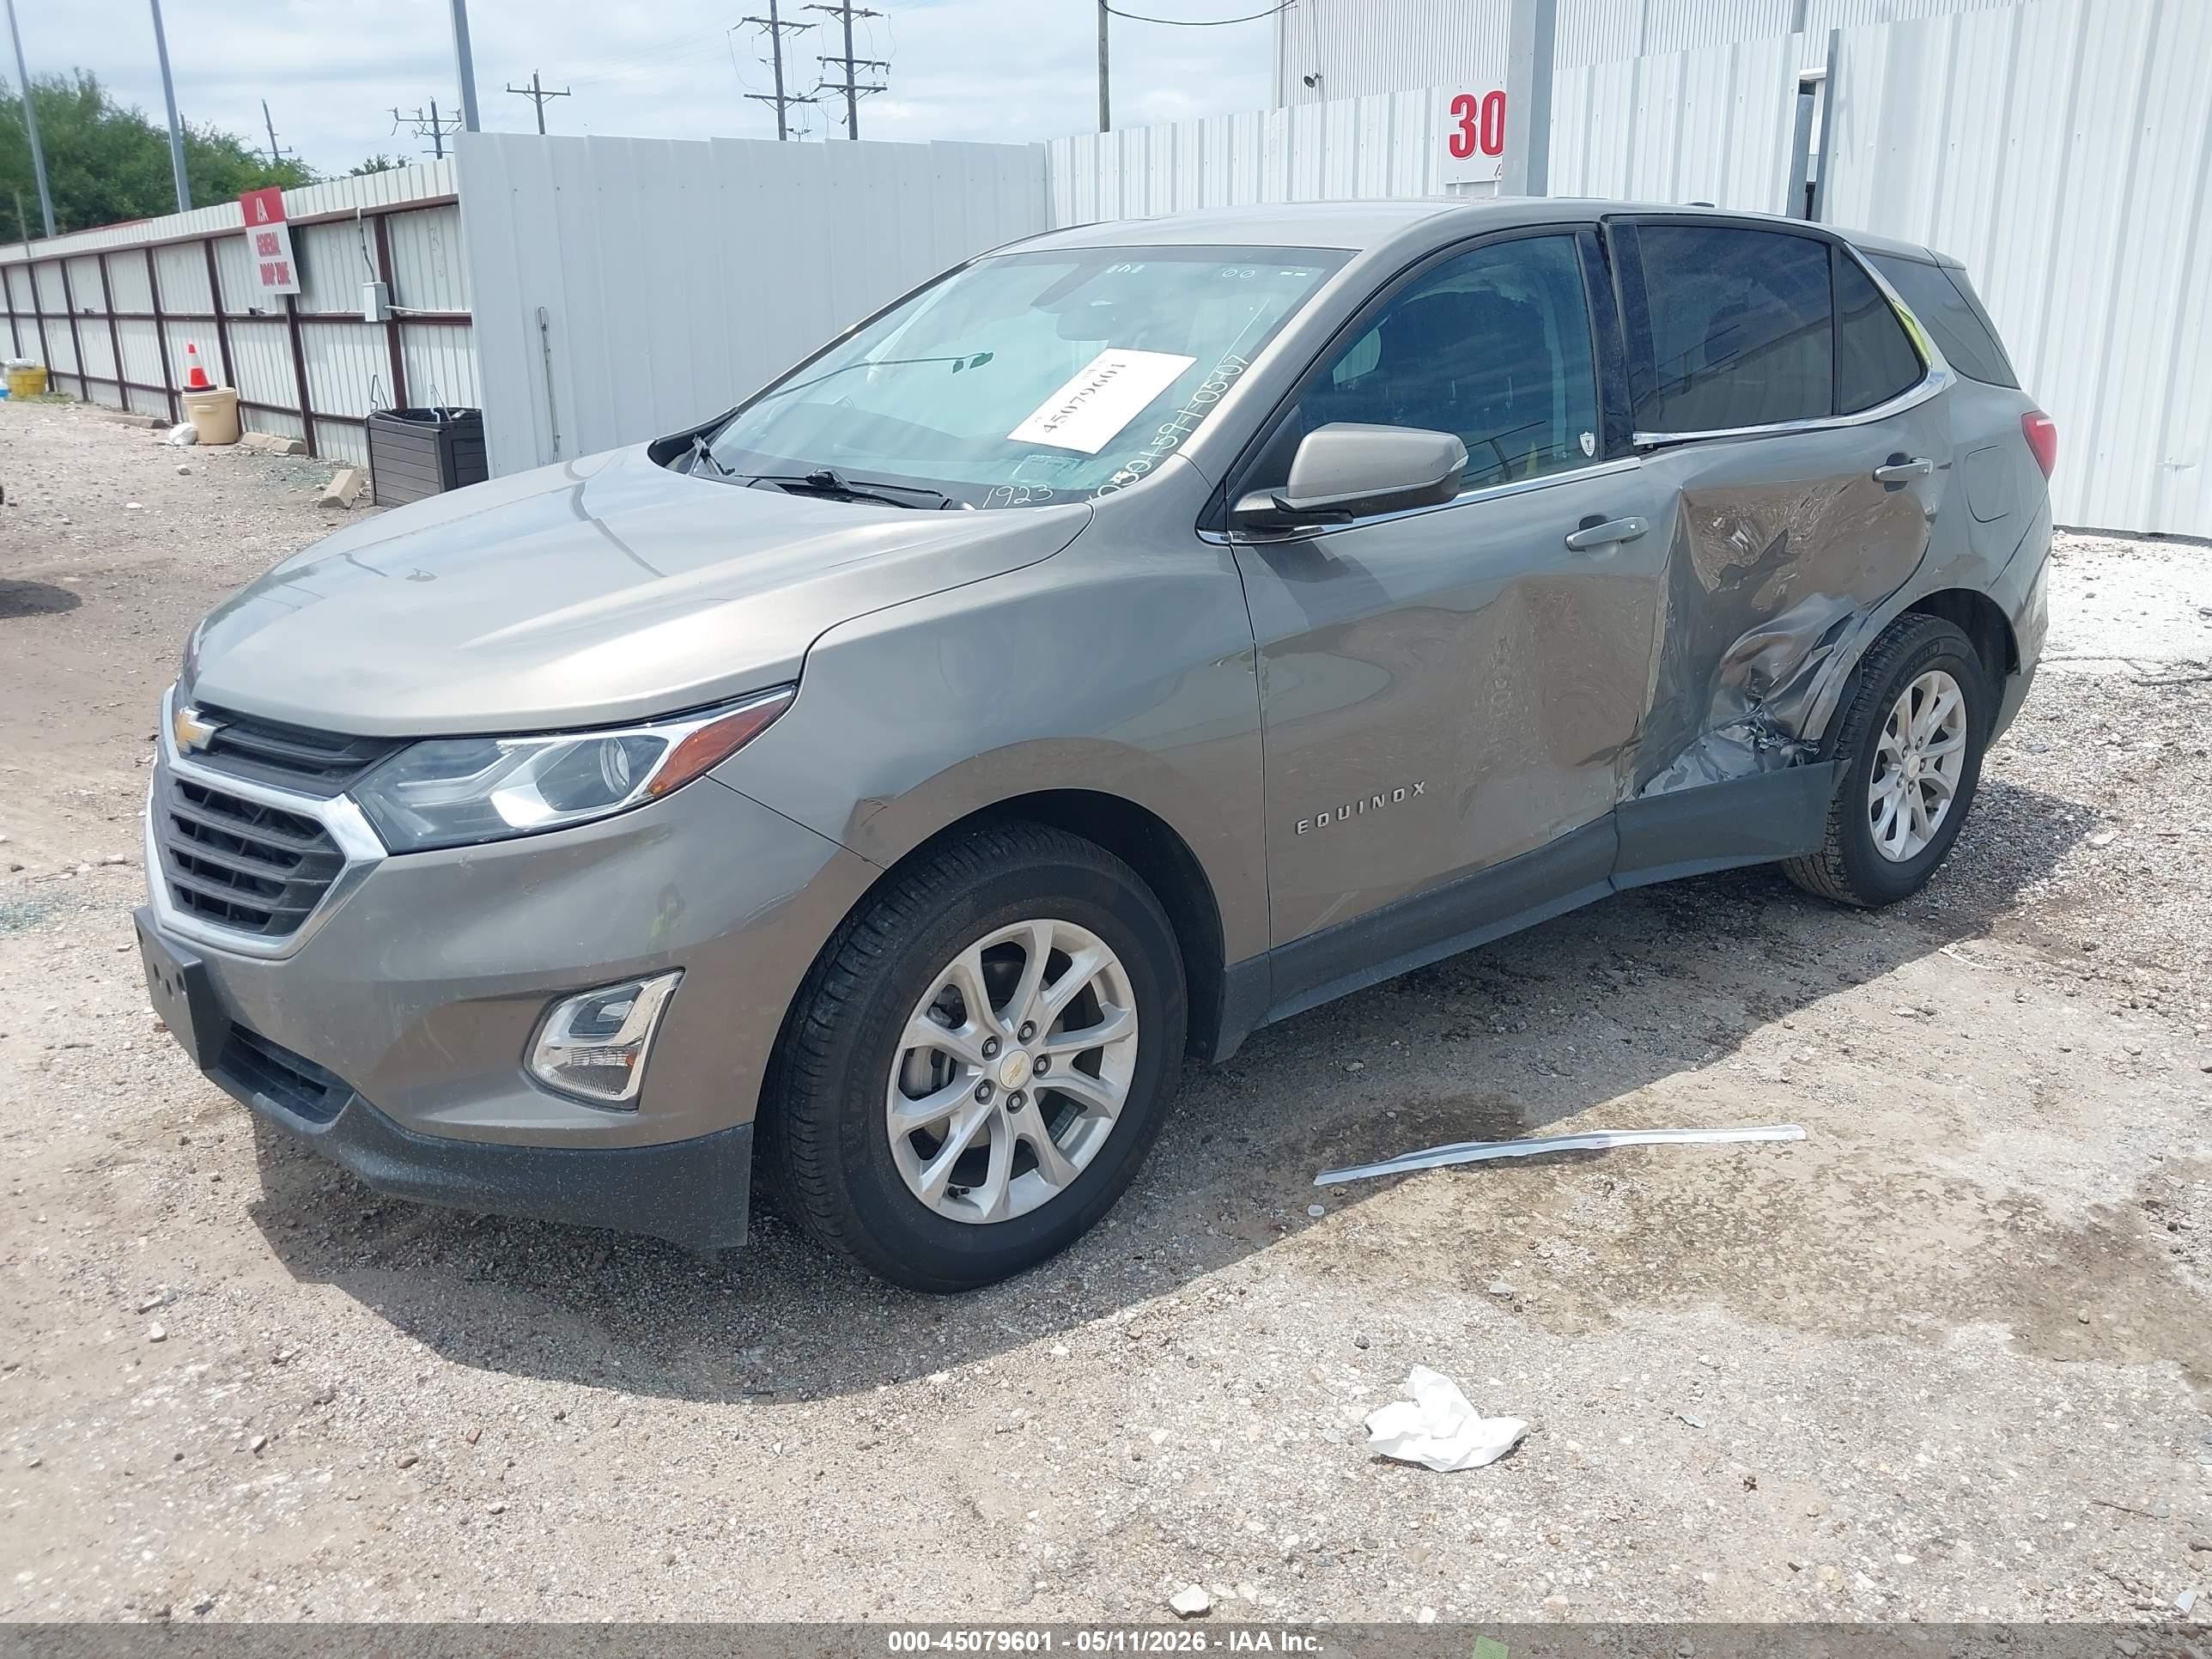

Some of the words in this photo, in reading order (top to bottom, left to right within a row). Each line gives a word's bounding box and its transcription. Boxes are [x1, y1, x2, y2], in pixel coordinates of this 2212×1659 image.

[1449, 90, 1506, 159] 30
[1043, 362, 1127, 434] 45079601
[982, 483, 1054, 508] 1923
[1296, 781, 1425, 835] EQUINOX
